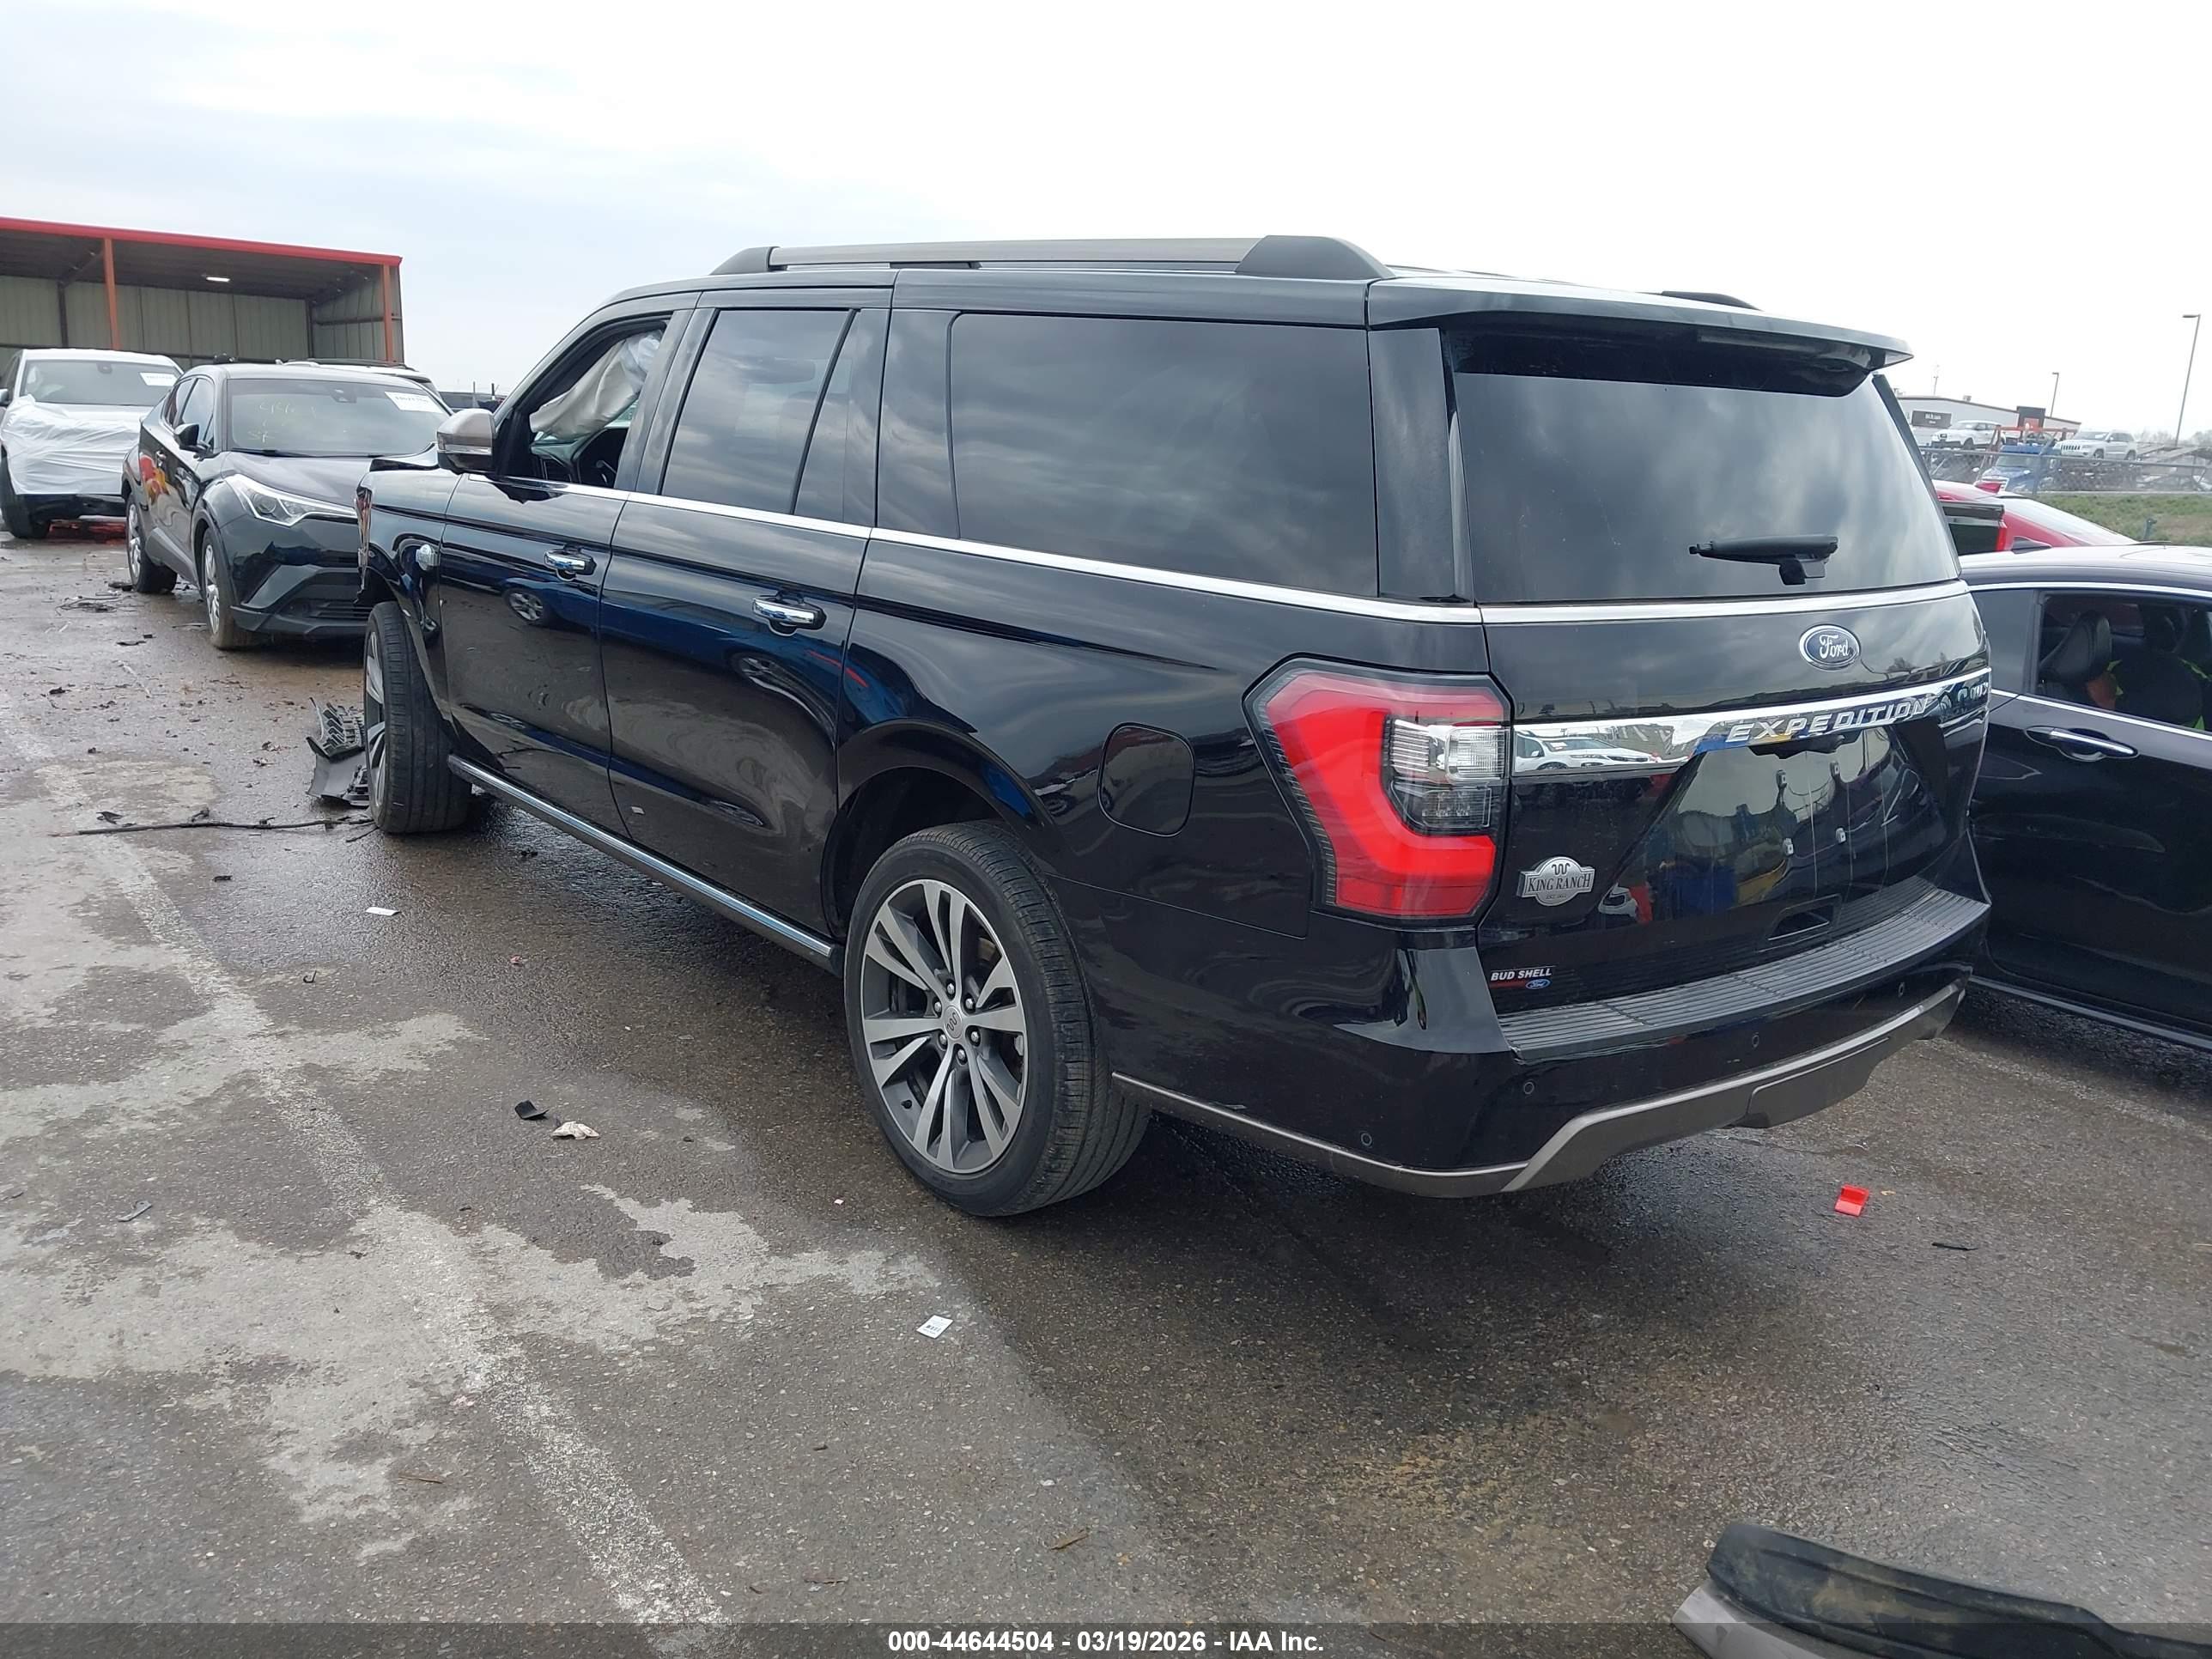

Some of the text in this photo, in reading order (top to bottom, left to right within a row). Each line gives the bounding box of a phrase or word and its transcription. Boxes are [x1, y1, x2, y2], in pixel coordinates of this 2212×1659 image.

[1819, 634, 1850, 659] Ford
[1724, 696, 1929, 743] EXPEDITION
[1528, 872, 1591, 892] KING RANCH
[1490, 968, 1553, 981] BUD SHELL
